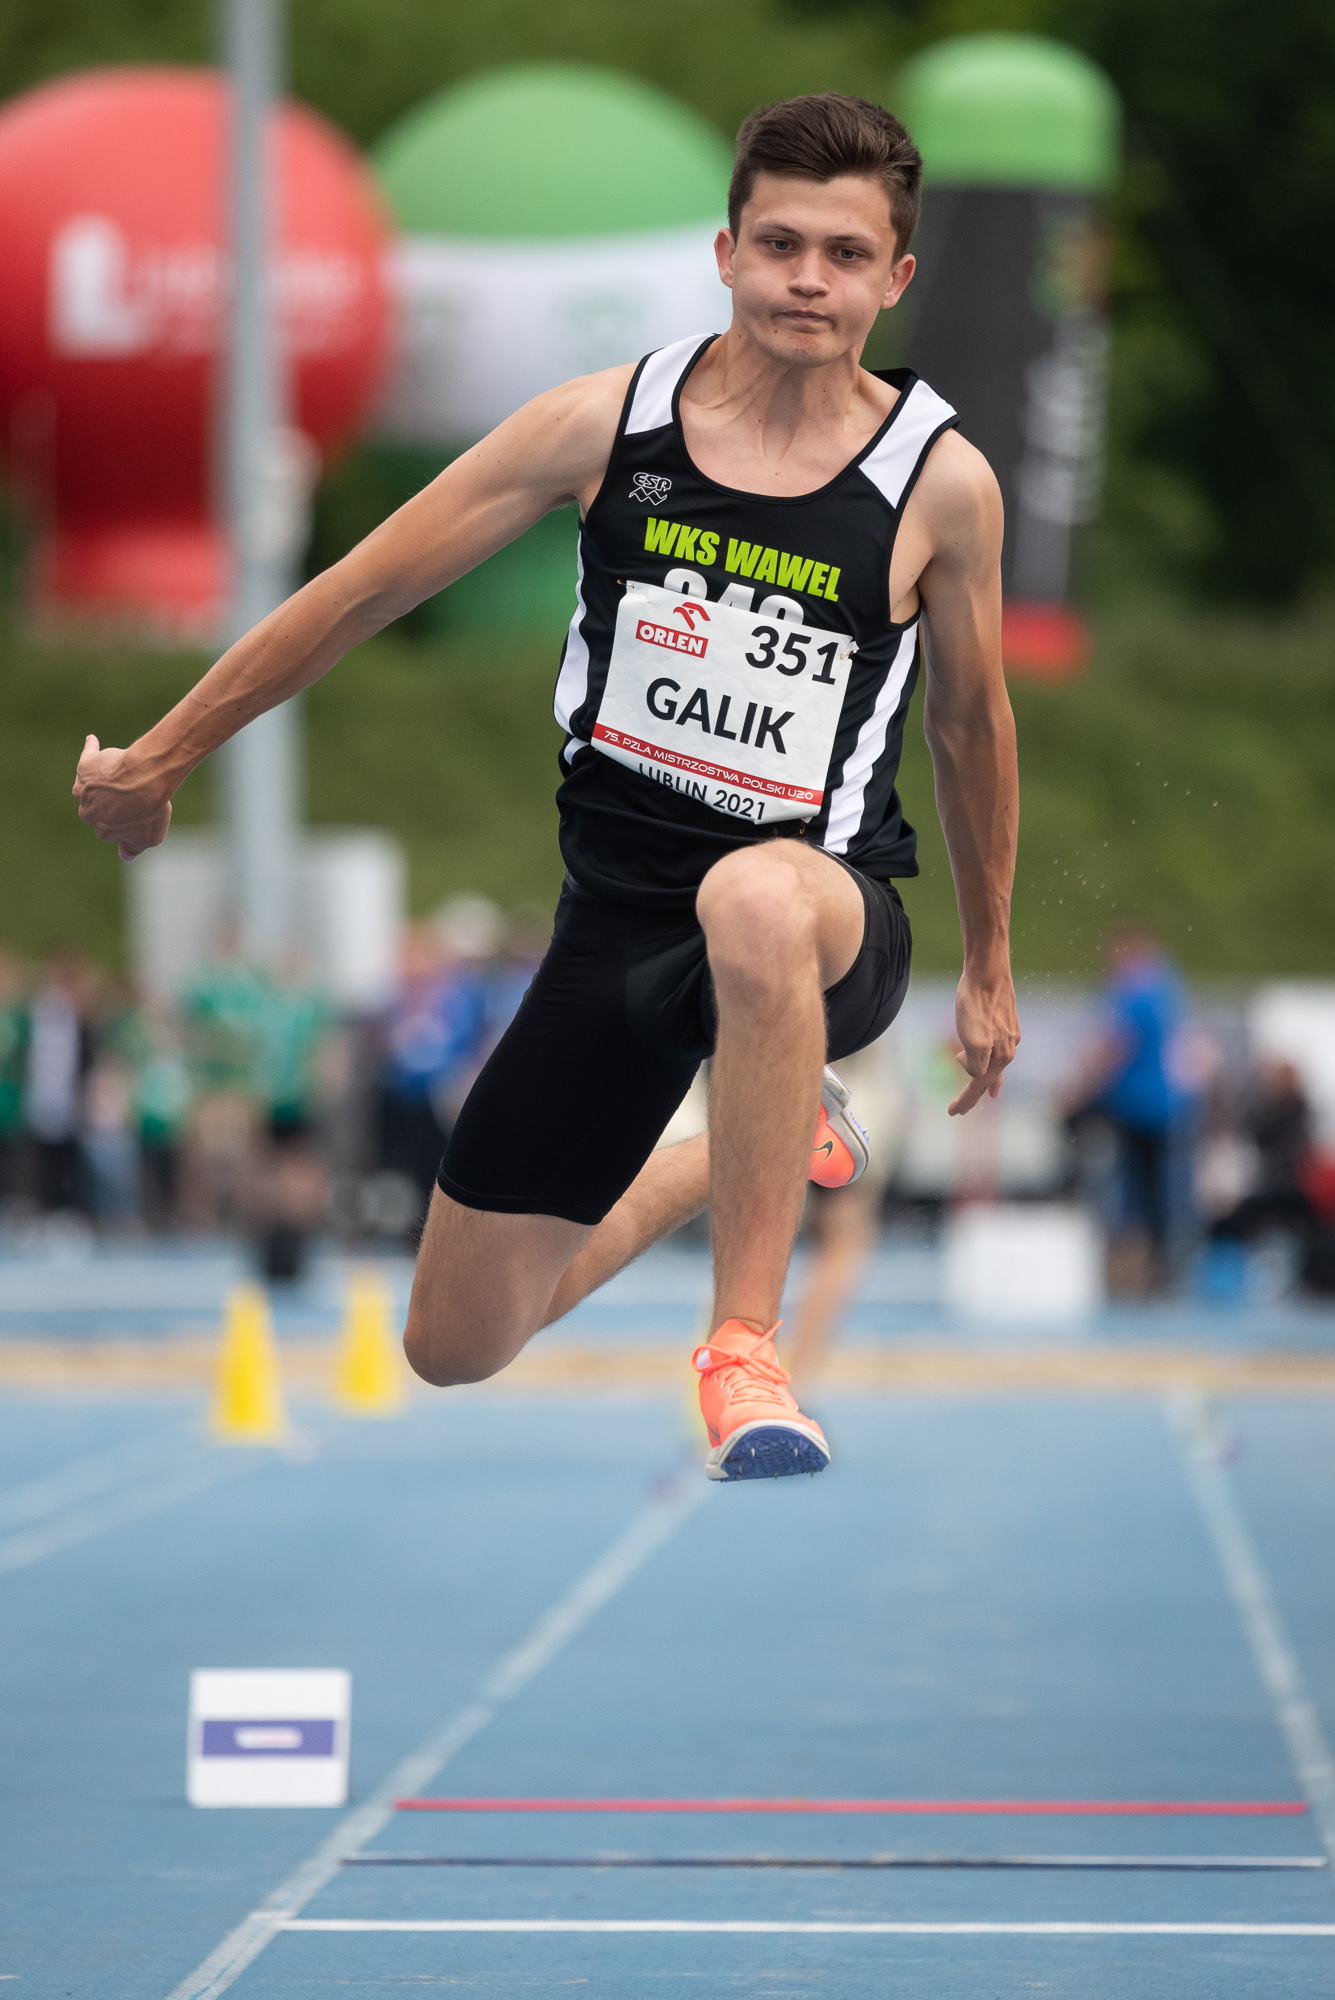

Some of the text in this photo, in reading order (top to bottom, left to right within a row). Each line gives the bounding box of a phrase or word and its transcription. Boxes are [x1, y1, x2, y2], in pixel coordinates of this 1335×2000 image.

[644, 517, 720, 566] WKS
[724, 537, 841, 602] WAWEL
[639, 624, 704, 655] ORLEN
[745, 625, 839, 685] 351
[646, 677, 796, 754] GALIK
[604, 730, 814, 801] 75. PZLA MISTRZOSTWA POLSKI U20
[713, 789, 765, 821] 2021
